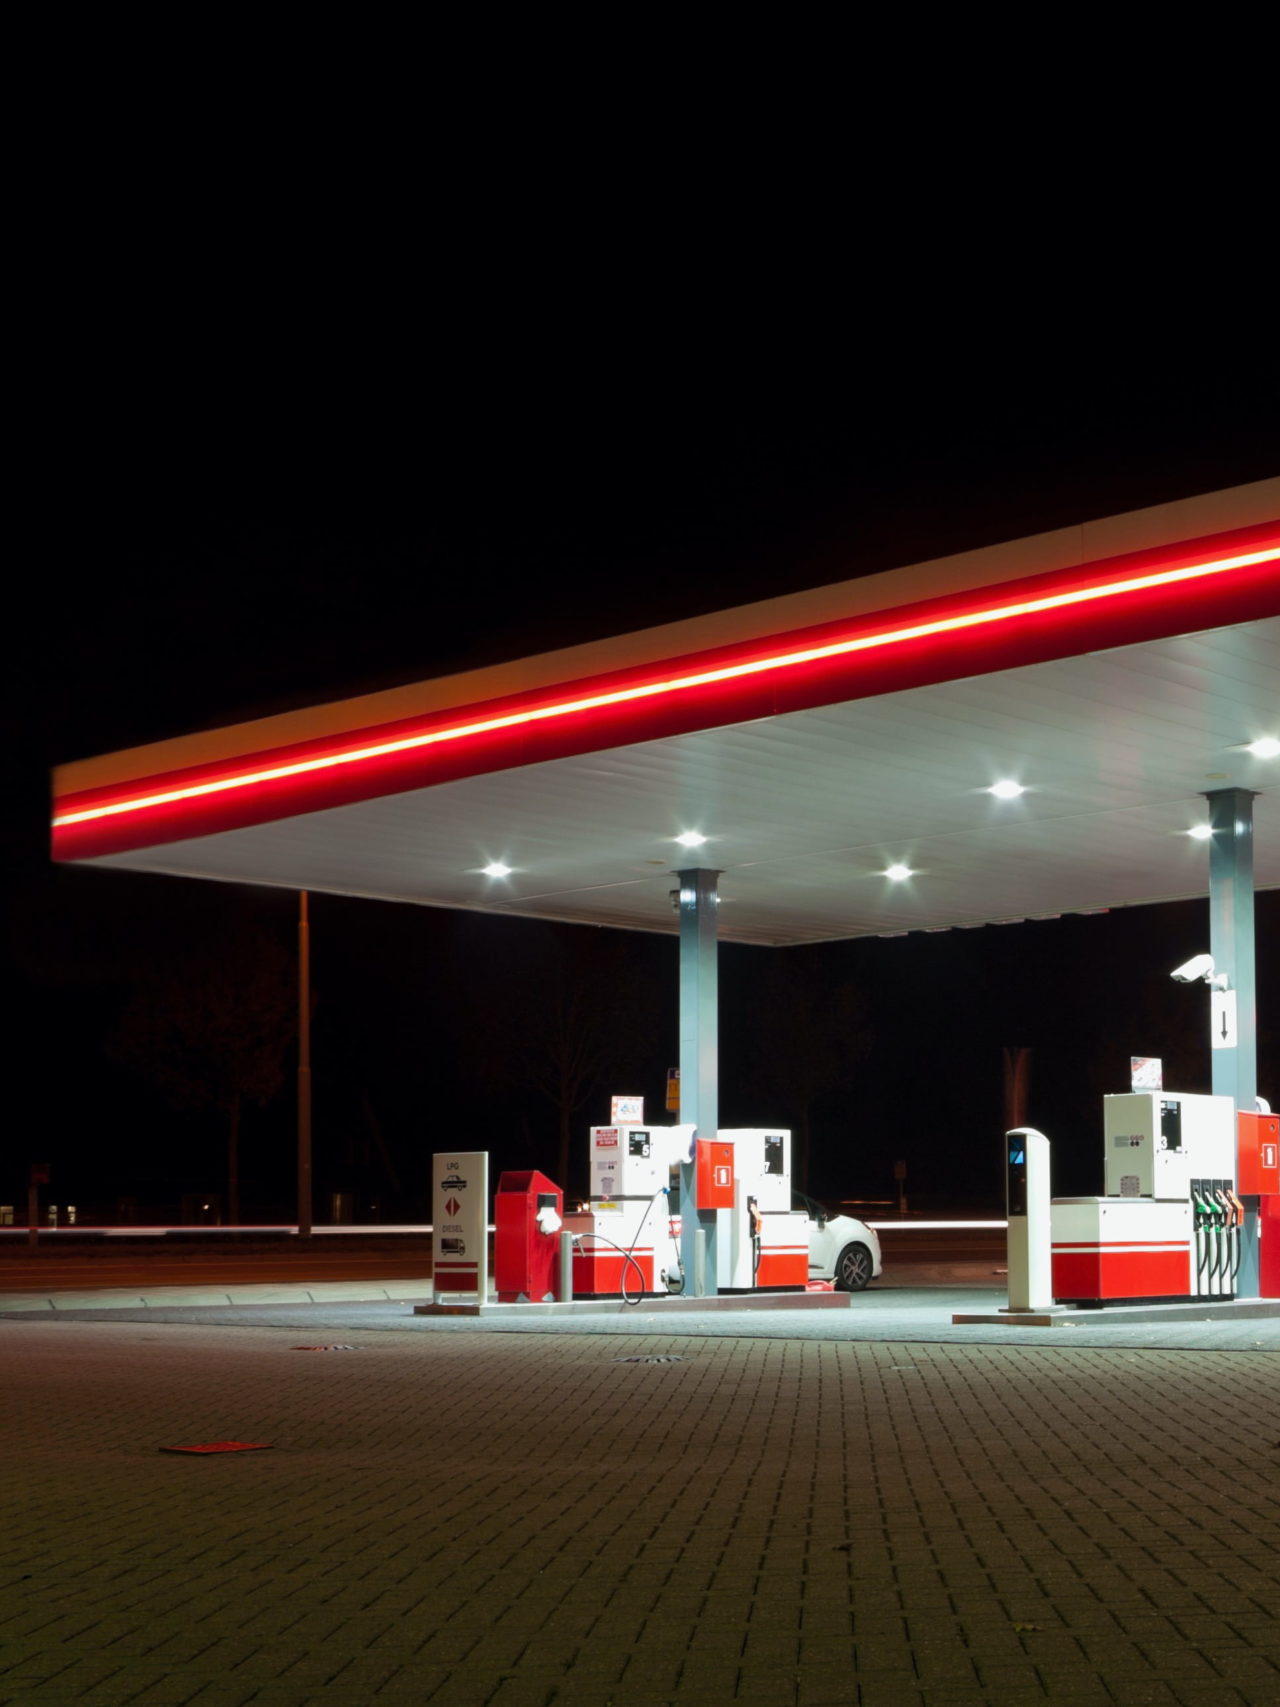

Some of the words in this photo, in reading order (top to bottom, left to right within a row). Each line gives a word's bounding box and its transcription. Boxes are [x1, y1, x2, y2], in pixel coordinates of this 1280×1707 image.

[1160, 1136, 1168, 1150] 3
[641, 1144, 650, 1156] 5
[446, 1162, 460, 1170] LPG
[442, 1225, 464, 1233] DIESEL
